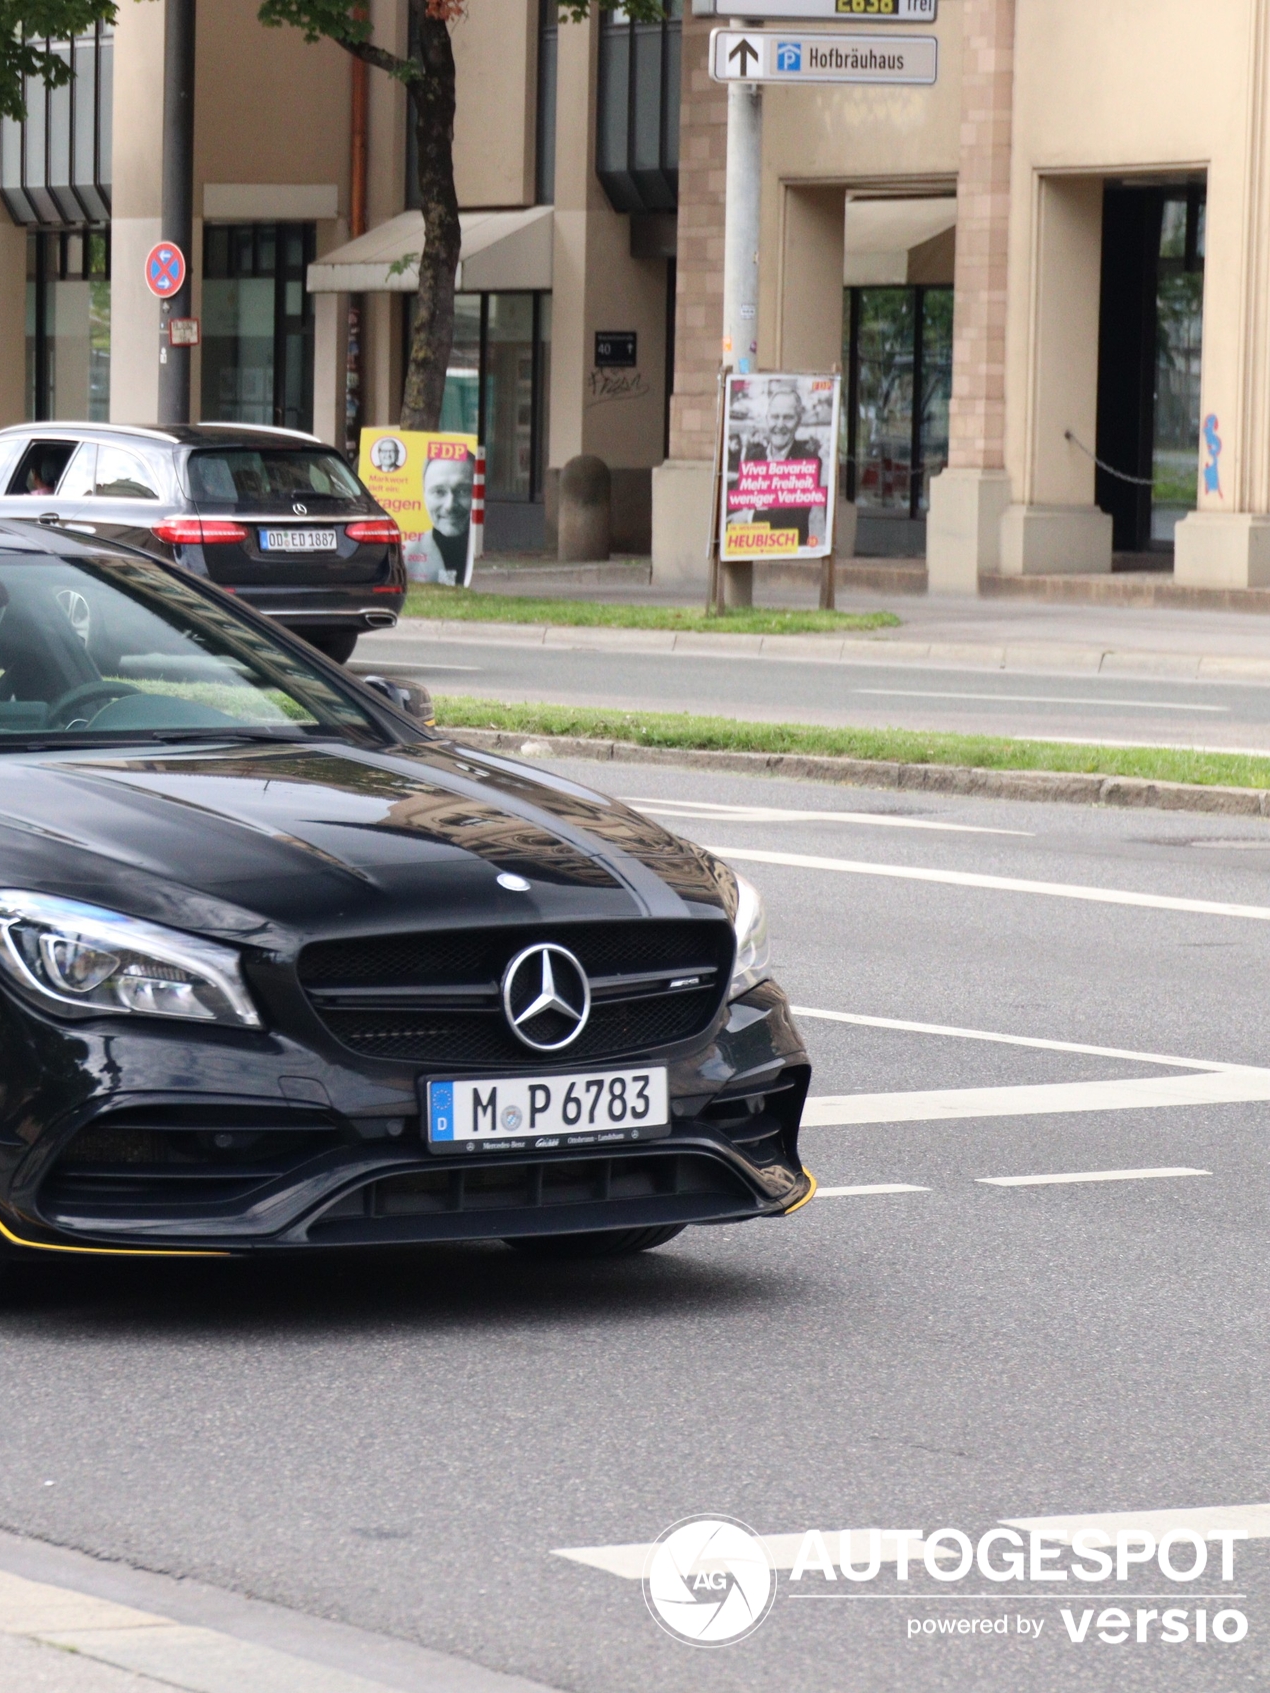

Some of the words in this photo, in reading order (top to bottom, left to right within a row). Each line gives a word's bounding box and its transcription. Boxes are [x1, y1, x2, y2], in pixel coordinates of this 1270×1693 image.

[809, 47, 904, 70] Hofbräuhaus
[598, 343, 611, 355] 40
[429, 443, 466, 459] FDP
[741, 462, 767, 476] Viva
[768, 461, 817, 475] Bavaria:
[369, 474, 408, 484] Markwort
[739, 478, 770, 491] Mehr
[771, 475, 815, 490] Freiheit,
[372, 495, 421, 513] ragen
[730, 492, 776, 506] weniger
[777, 490, 826, 504] Verbote.
[269, 533, 283, 547] OD
[291, 533, 306, 547] ED
[308, 533, 335, 547] 1887
[728, 533, 796, 548] HEUBISCH
[472, 1086, 498, 1132] M
[528, 1084, 551, 1129] P
[562, 1075, 650, 1126] 6783
[437, 1117, 448, 1131] D
[483, 1141, 526, 1150] Mercedes-Benz
